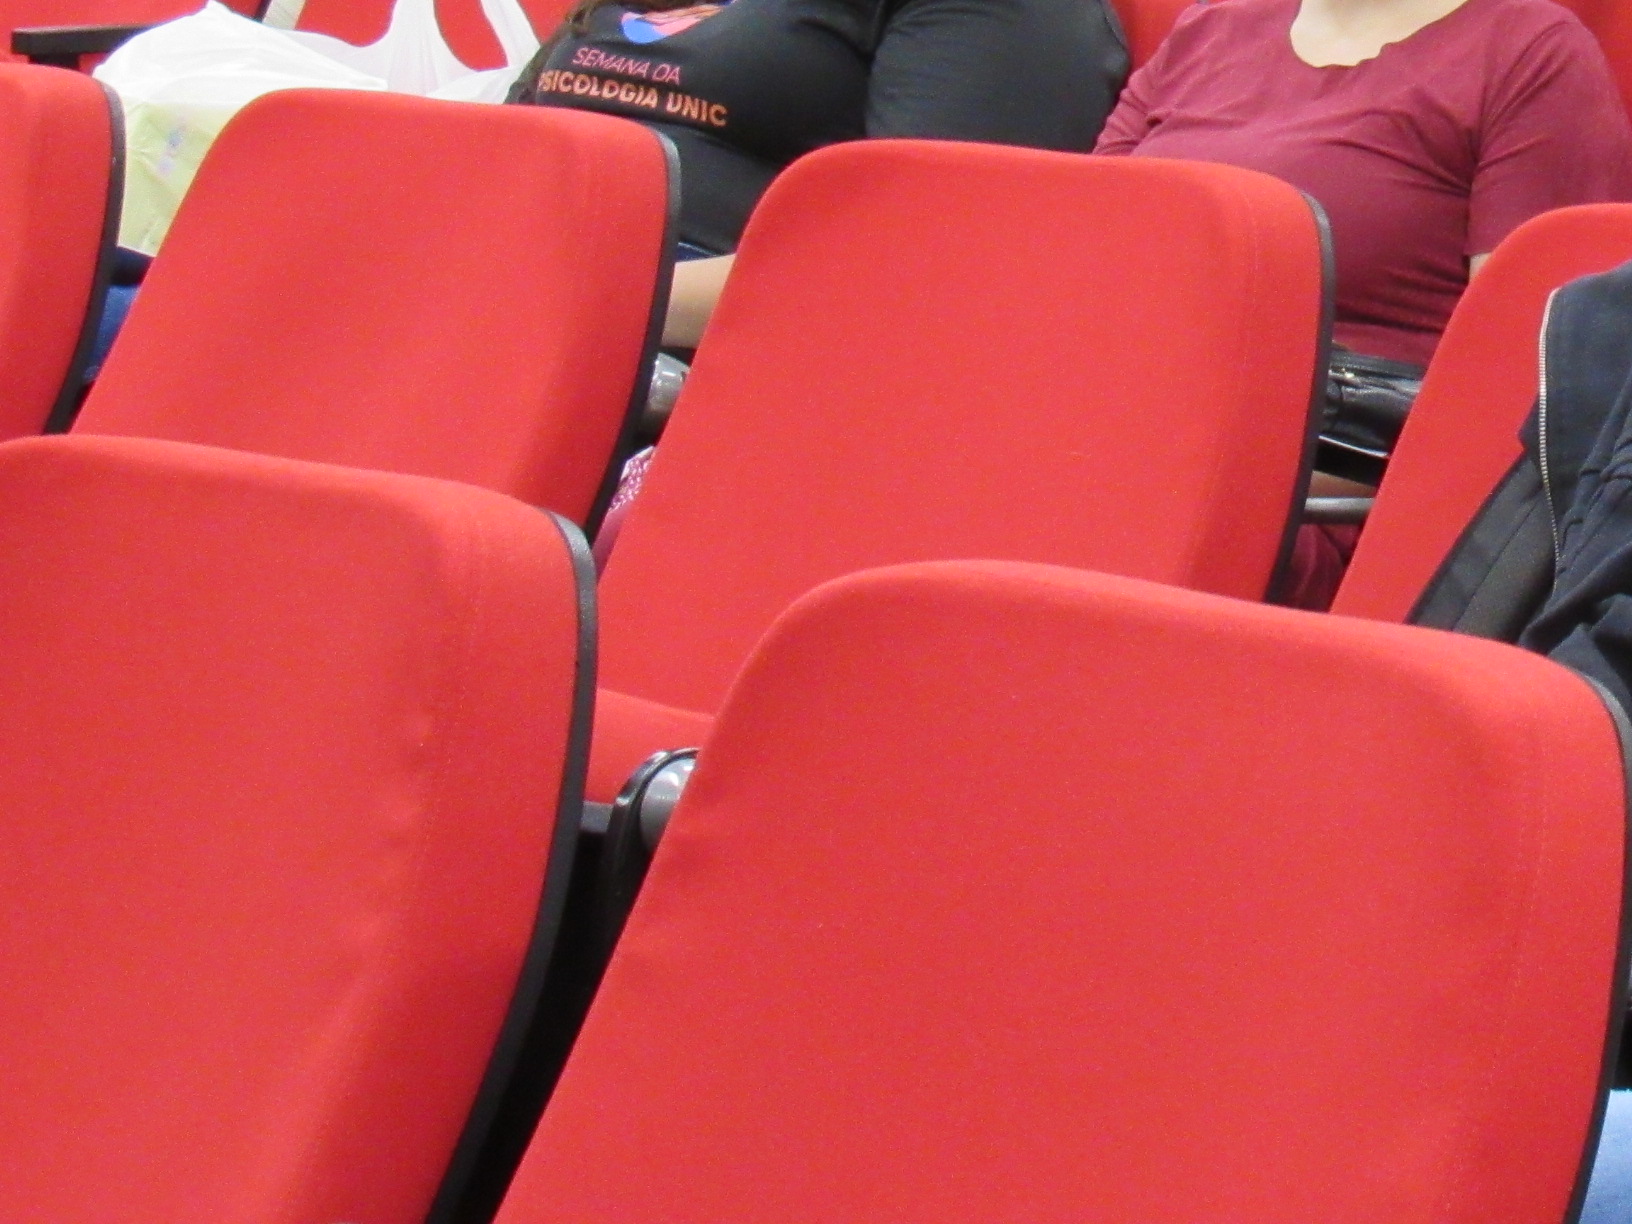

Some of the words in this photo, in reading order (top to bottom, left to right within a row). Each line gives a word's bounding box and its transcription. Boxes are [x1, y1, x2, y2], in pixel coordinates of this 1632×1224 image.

[572, 47, 650, 78] SEMANA
[653, 64, 681, 85] DA
[538, 69, 659, 109] SICOLOGIA
[666, 93, 727, 127] UNIC
